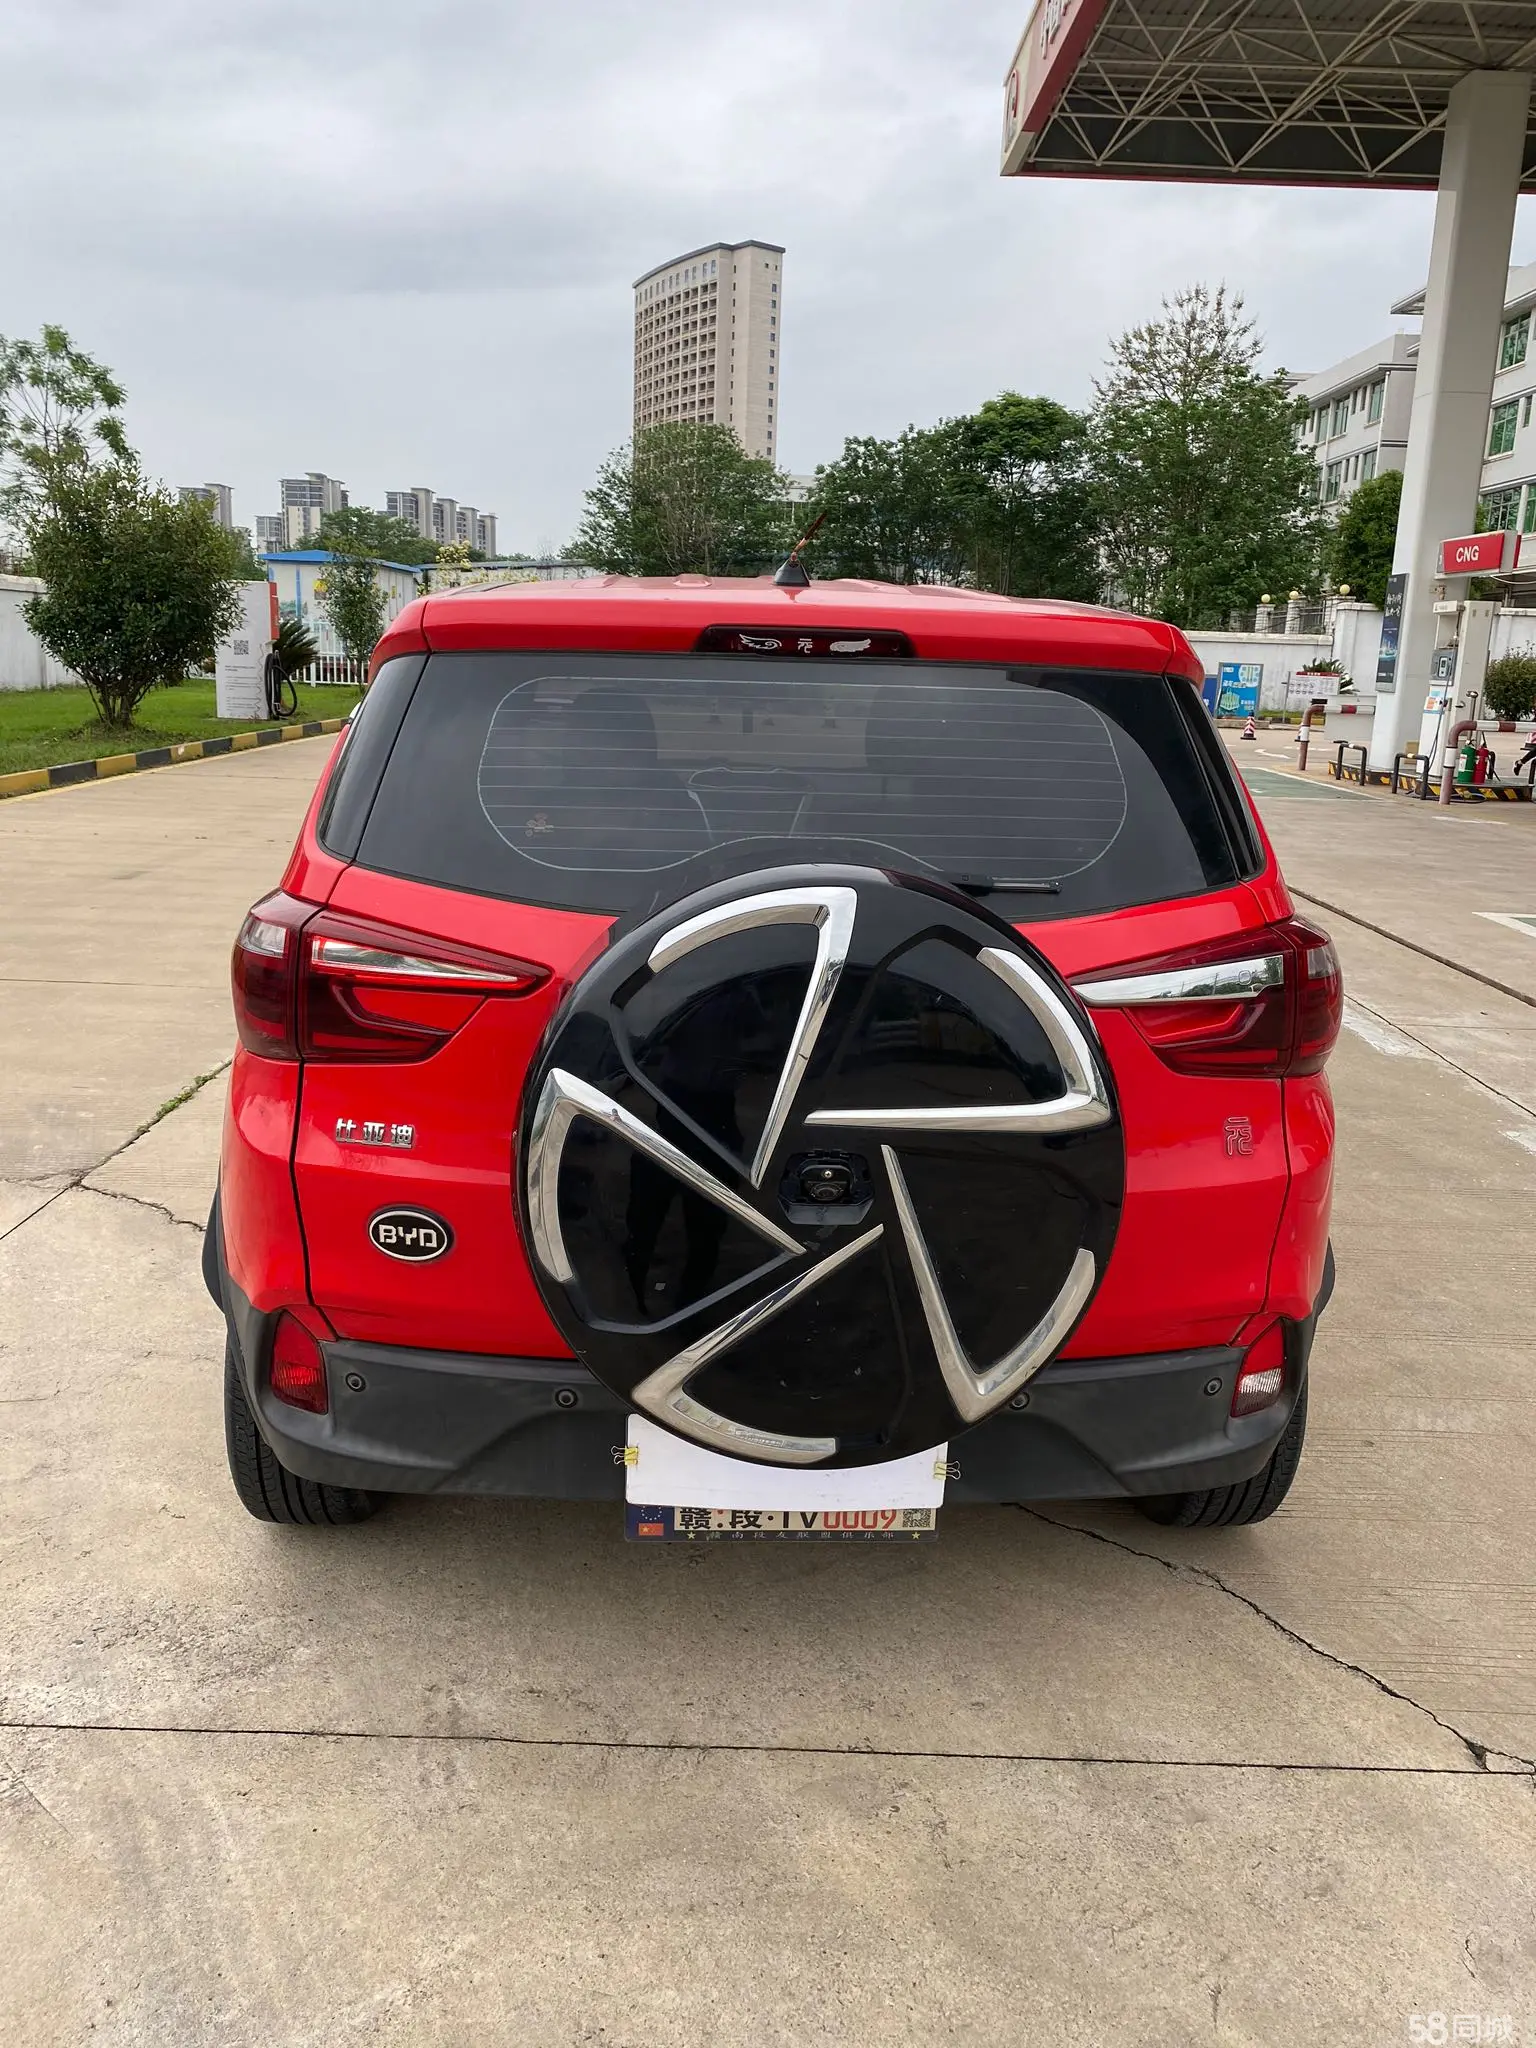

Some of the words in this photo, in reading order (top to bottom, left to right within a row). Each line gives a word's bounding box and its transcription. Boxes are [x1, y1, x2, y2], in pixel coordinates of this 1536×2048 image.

[1456, 545, 1479, 562] CNG
[797, 638, 813, 654] 元
[336, 1118, 414, 1148] 比亚迪
[1225, 1116, 1253, 1155] 元
[378, 1224, 438, 1248] BYD
